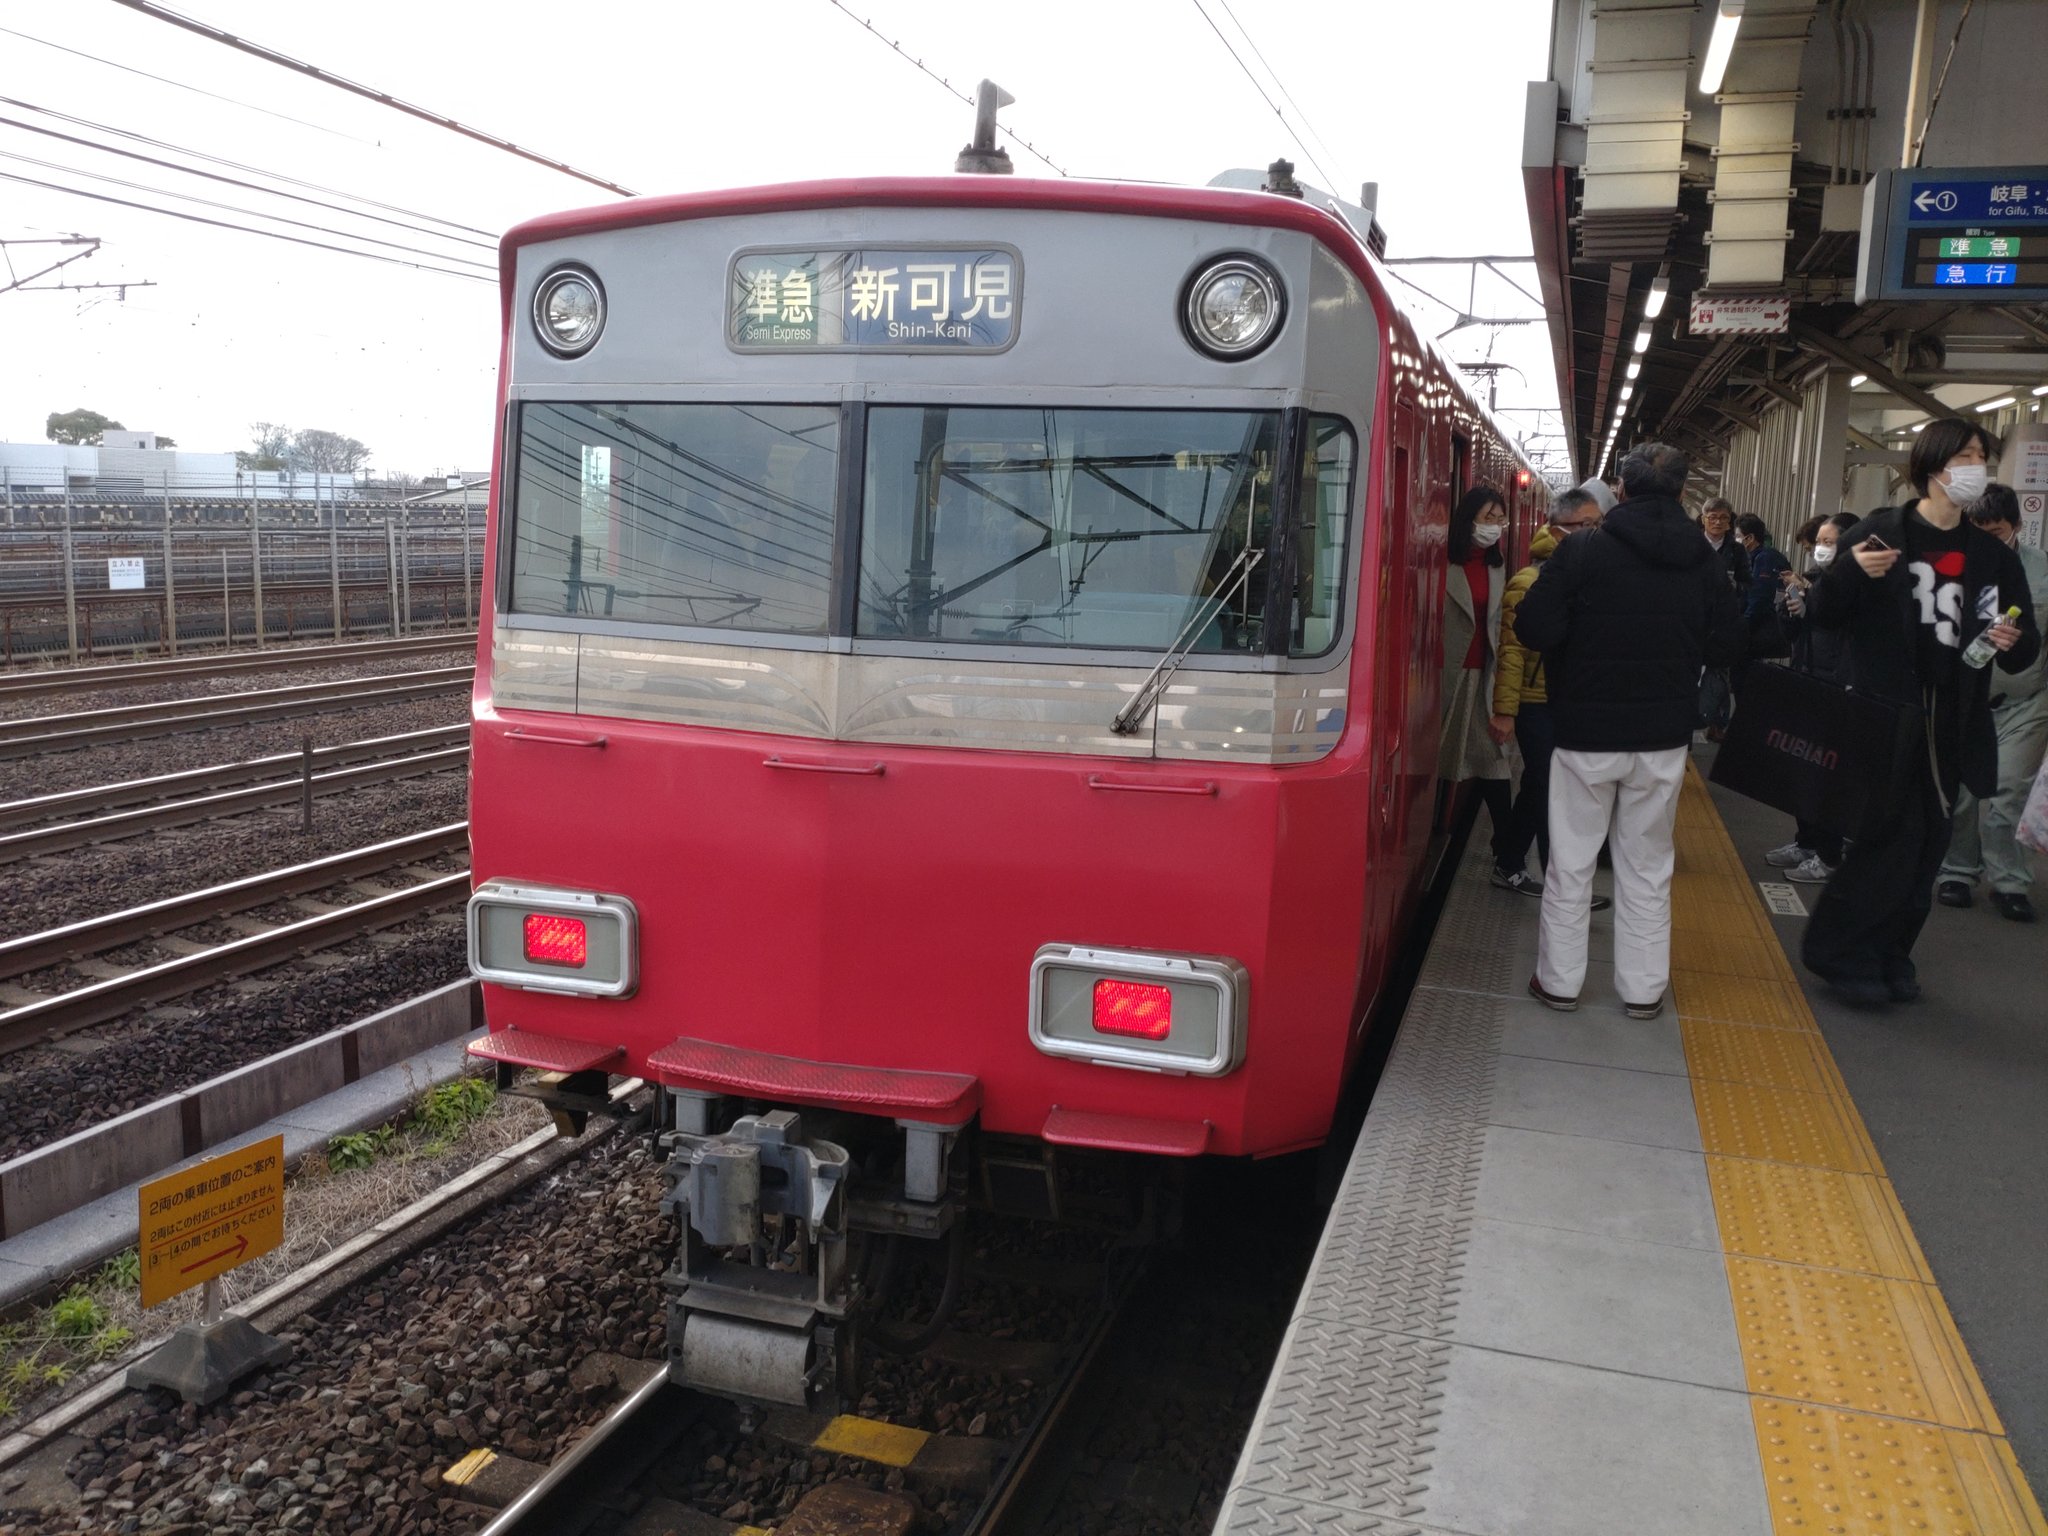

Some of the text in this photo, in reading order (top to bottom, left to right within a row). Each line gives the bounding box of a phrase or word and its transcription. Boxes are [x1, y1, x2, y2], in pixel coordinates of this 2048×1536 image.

[1988, 206, 2003, 216] for
[2005, 206, 2030, 217] Gifu,
[1945, 264, 2007, 283] 急行
[746, 269, 814, 324] 準急
[850, 263, 1012, 322] 新可児
[746, 325, 812, 342] Semi Express
[888, 322, 972, 339] Shin-Kani
[149, 1155, 276, 1217] 2両の乗車位置のご案内
[150, 1183, 276, 1244] 2両はこの付近には止まりません
